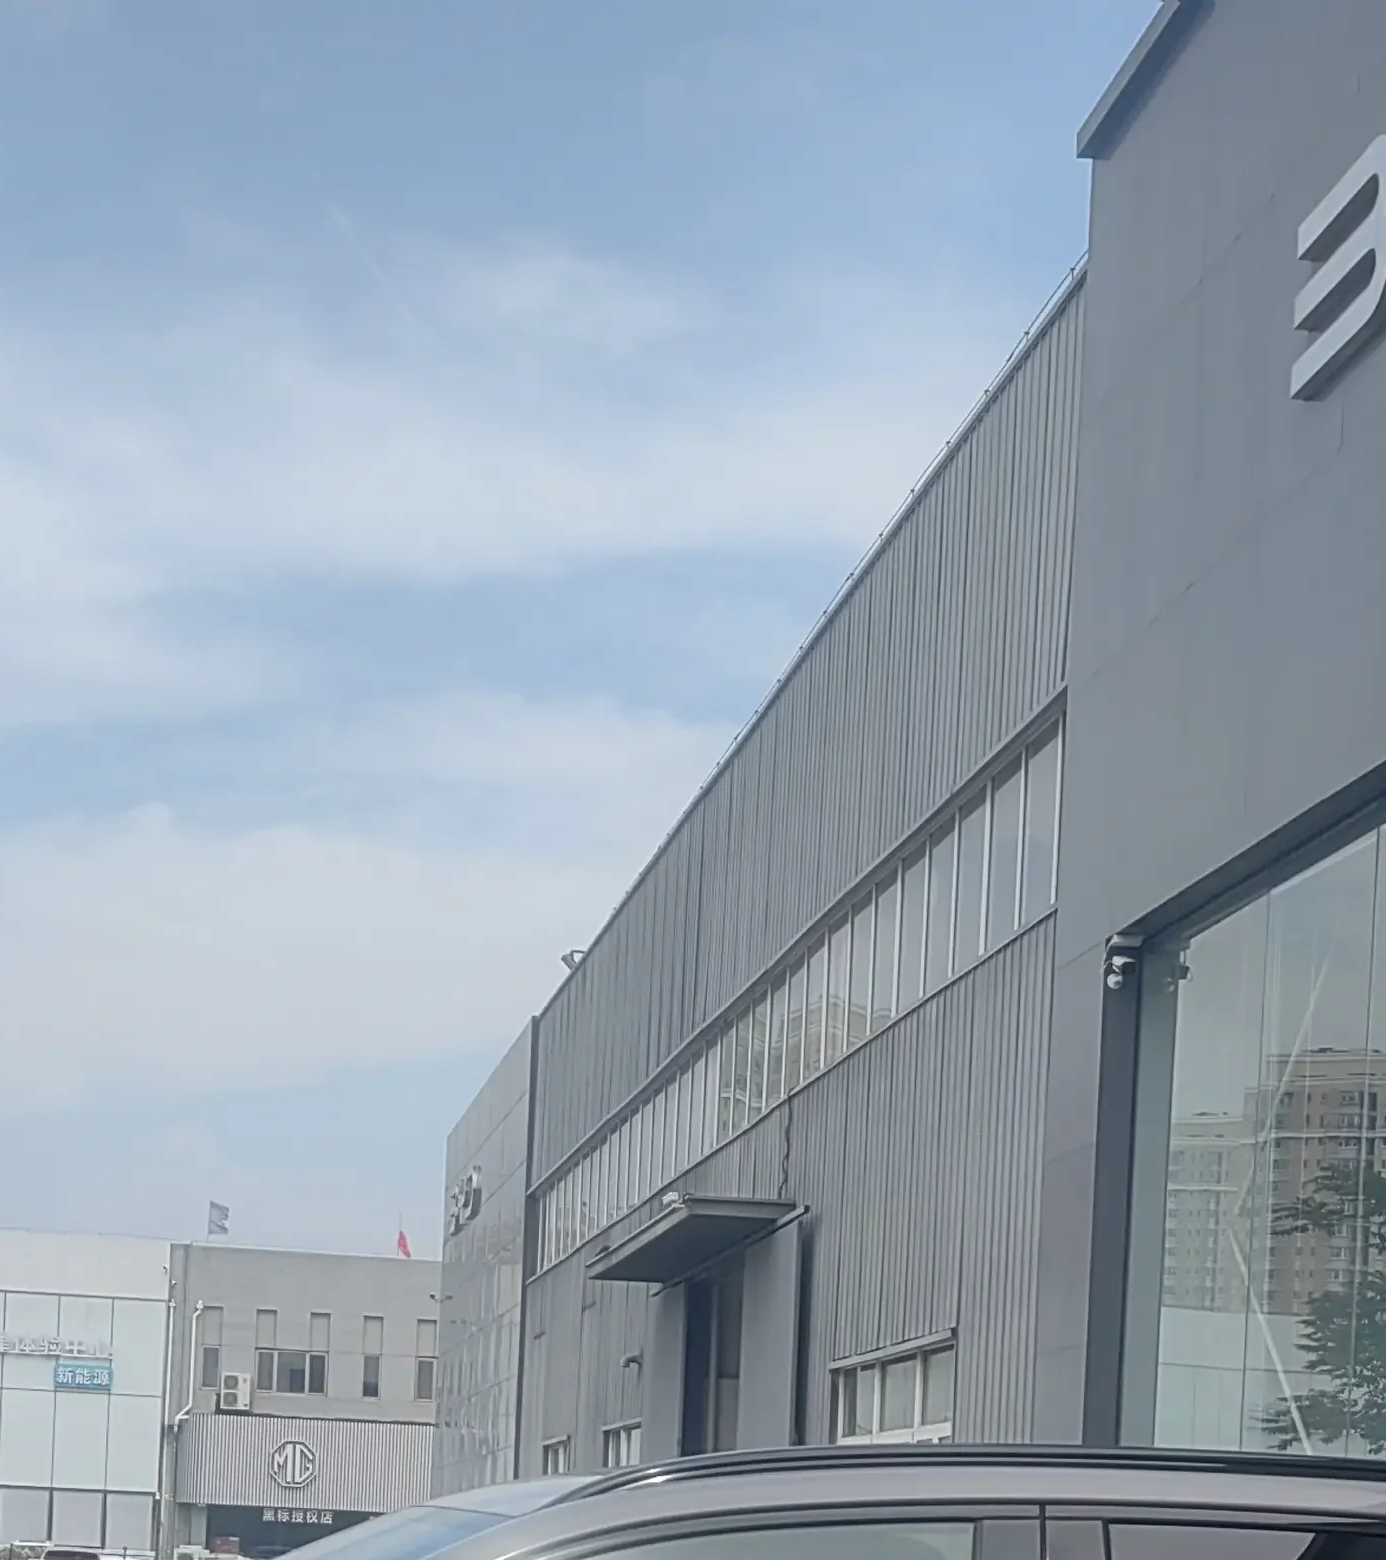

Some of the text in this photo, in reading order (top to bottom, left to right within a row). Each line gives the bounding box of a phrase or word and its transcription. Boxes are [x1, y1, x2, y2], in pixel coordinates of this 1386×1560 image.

[56, 1367, 110, 1385] 新能源
[273, 1443, 314, 1483] MG
[262, 1507, 333, 1525] 黑标授权店
